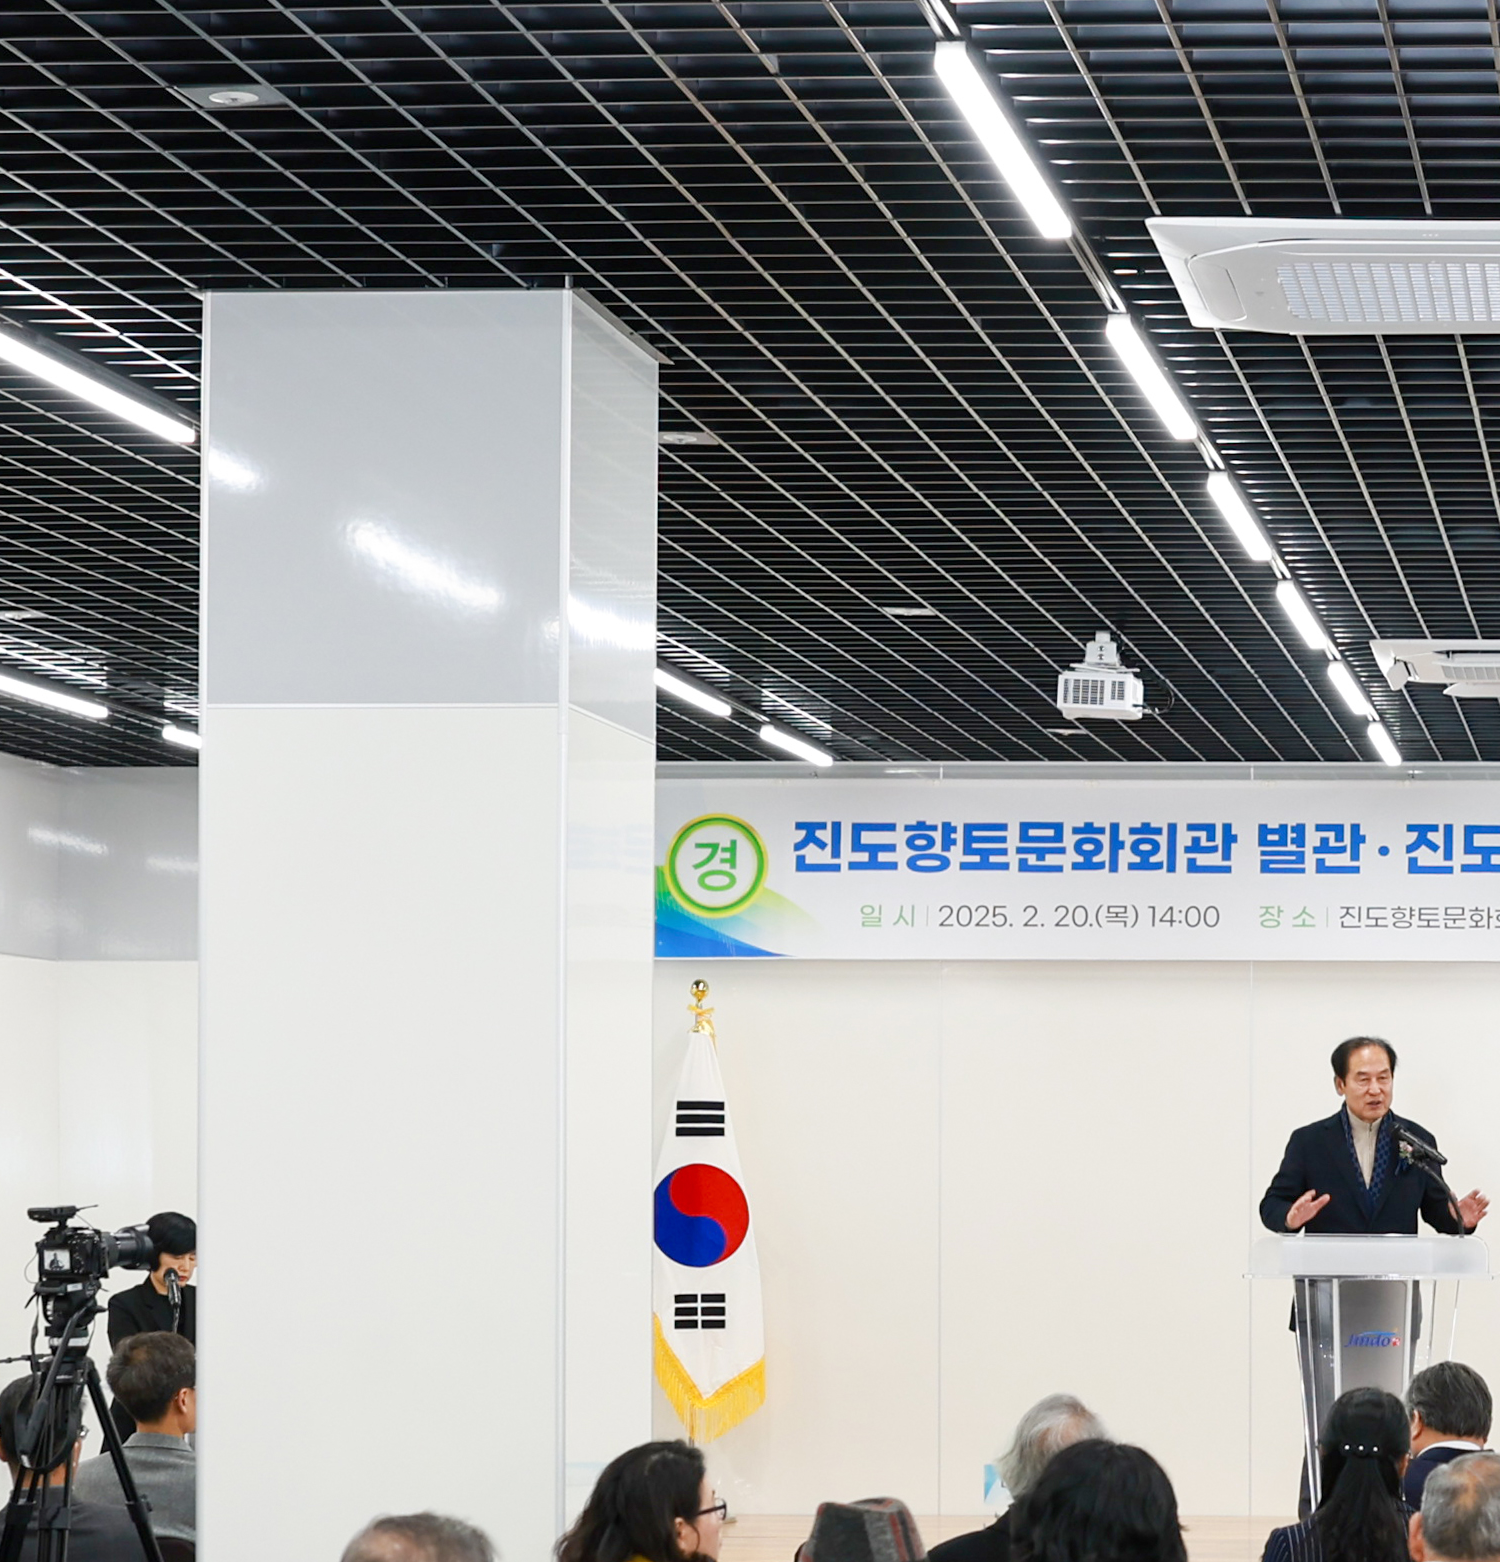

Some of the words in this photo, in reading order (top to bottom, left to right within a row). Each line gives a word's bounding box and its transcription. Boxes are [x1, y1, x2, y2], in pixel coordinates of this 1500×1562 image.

[692, 839, 738, 892] 경
[793, 820, 1239, 875] 진도향토문화회관
[938, 905, 1014, 928] 2025.
[1022, 905, 1045, 928] 2.
[1147, 906, 1221, 929] 14:00
